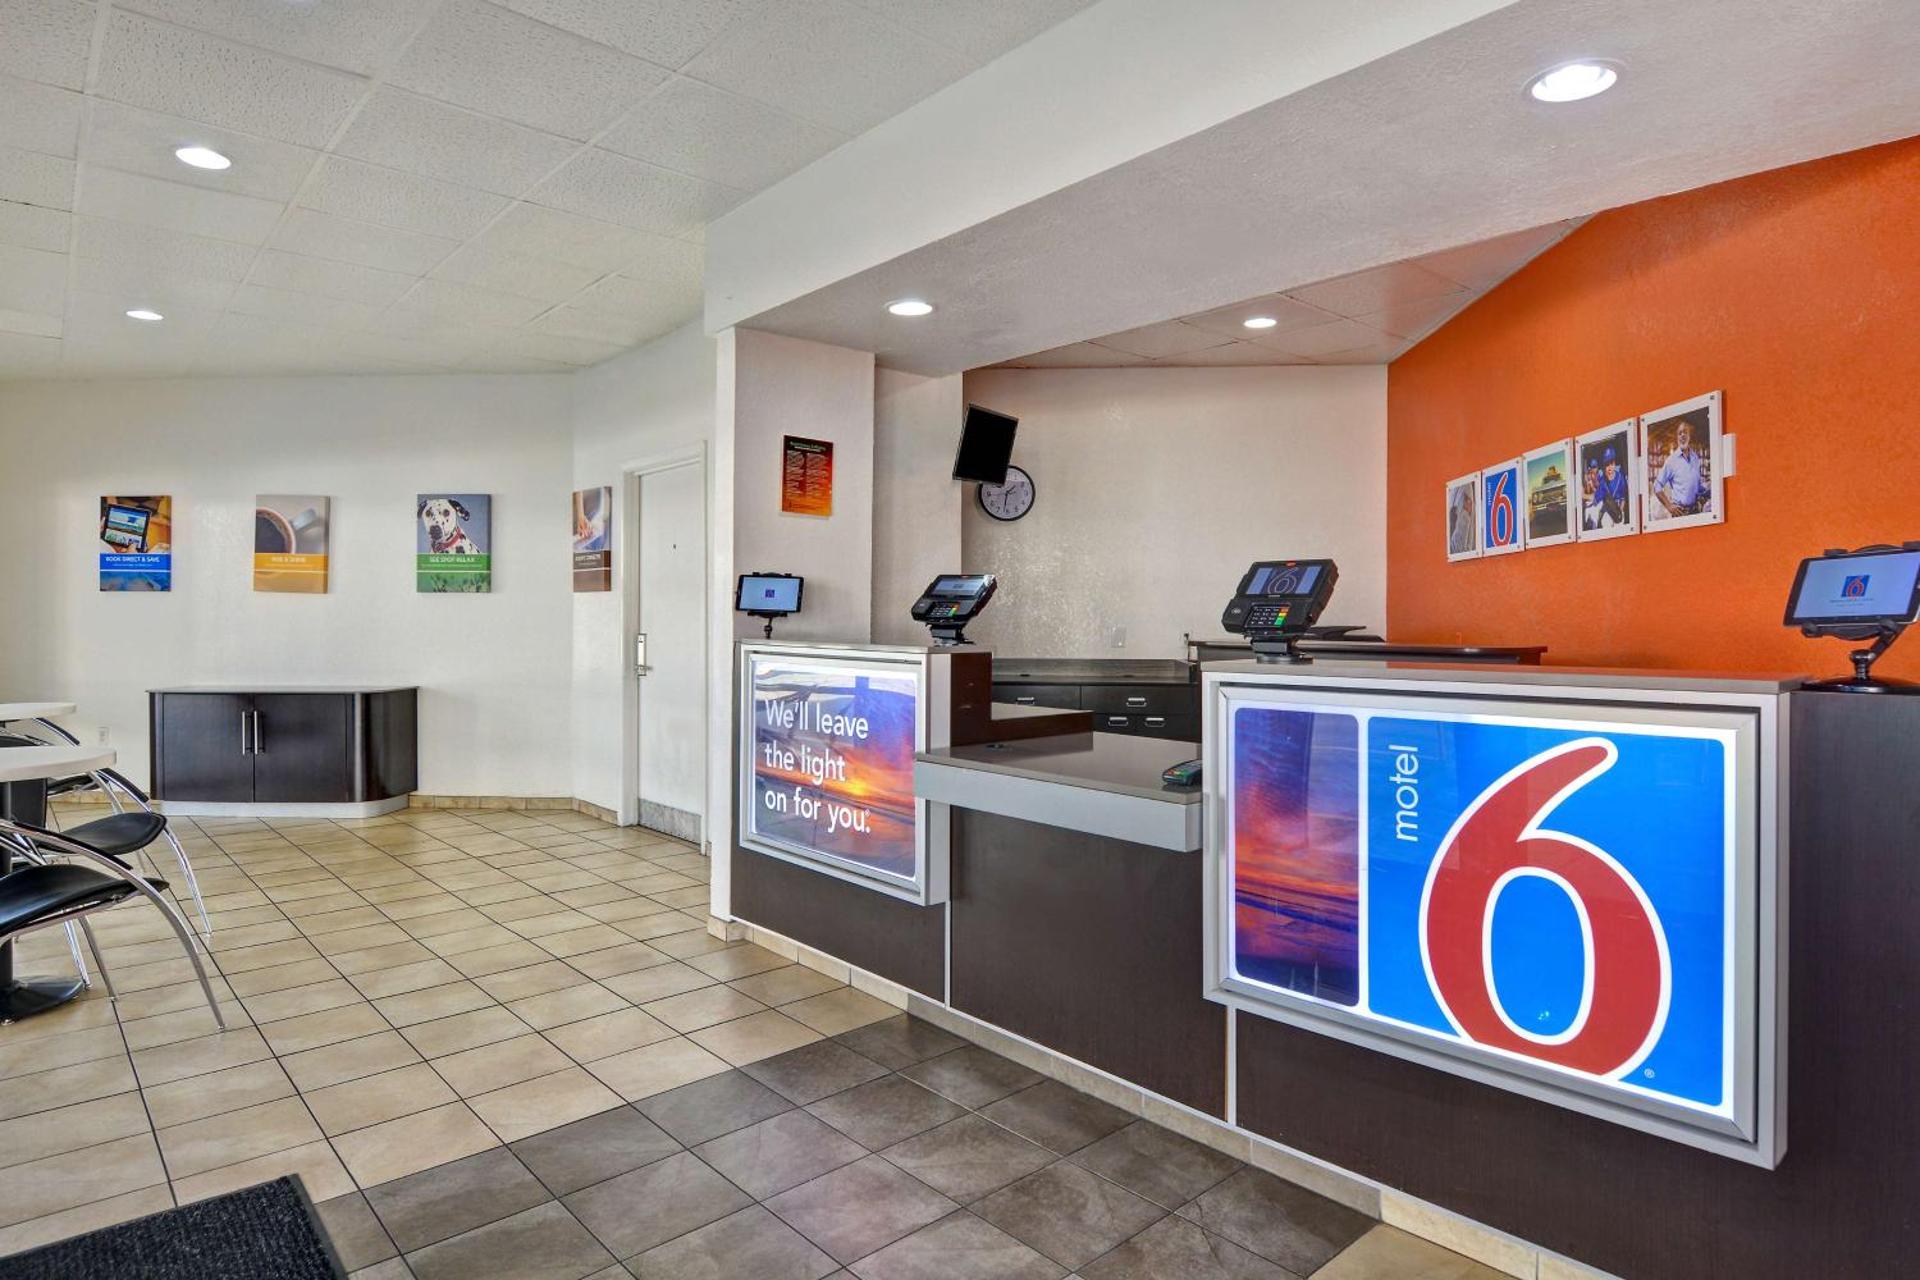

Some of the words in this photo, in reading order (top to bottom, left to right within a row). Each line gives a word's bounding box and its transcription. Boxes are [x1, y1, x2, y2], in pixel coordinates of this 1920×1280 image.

[1490, 472, 1514, 547] 6
[765, 700, 808, 731] We'll
[816, 702, 869, 739] leave
[765, 740, 794, 771] the
[801, 745, 846, 785] light
[765, 790, 787, 813] on
[794, 787, 821, 820] for
[1389, 745, 1419, 842] motel
[1420, 737, 1671, 1080] 6
